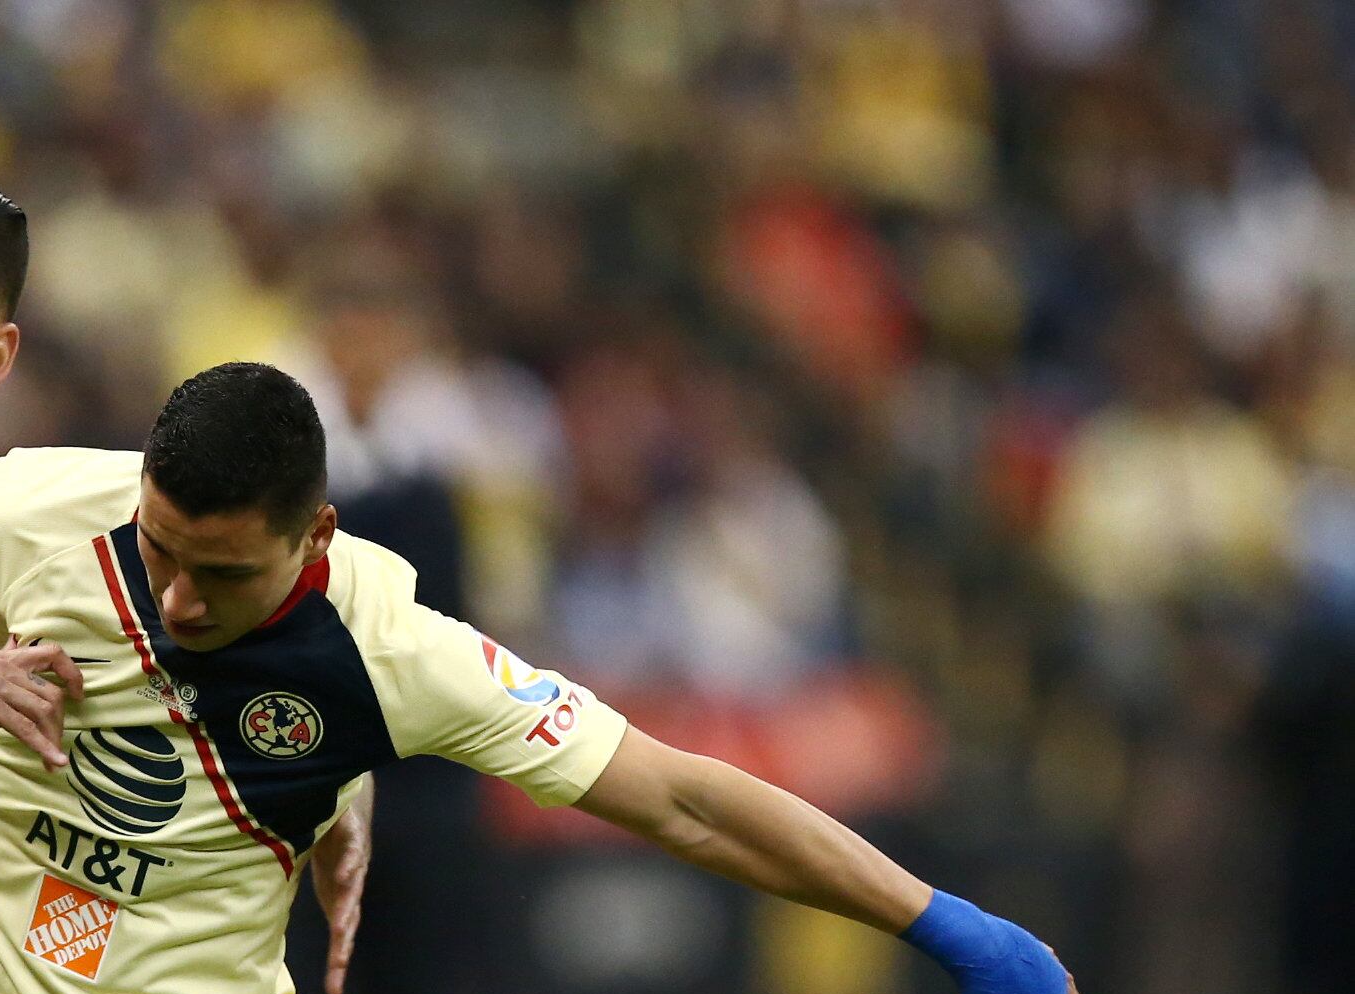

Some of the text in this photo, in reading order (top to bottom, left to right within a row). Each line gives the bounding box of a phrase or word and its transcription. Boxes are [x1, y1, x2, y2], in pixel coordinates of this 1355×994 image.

[25, 810, 166, 897] AT&T
[27, 899, 120, 957] HOME
[43, 893, 79, 918] THE
[53, 928, 108, 968] DEPOT
